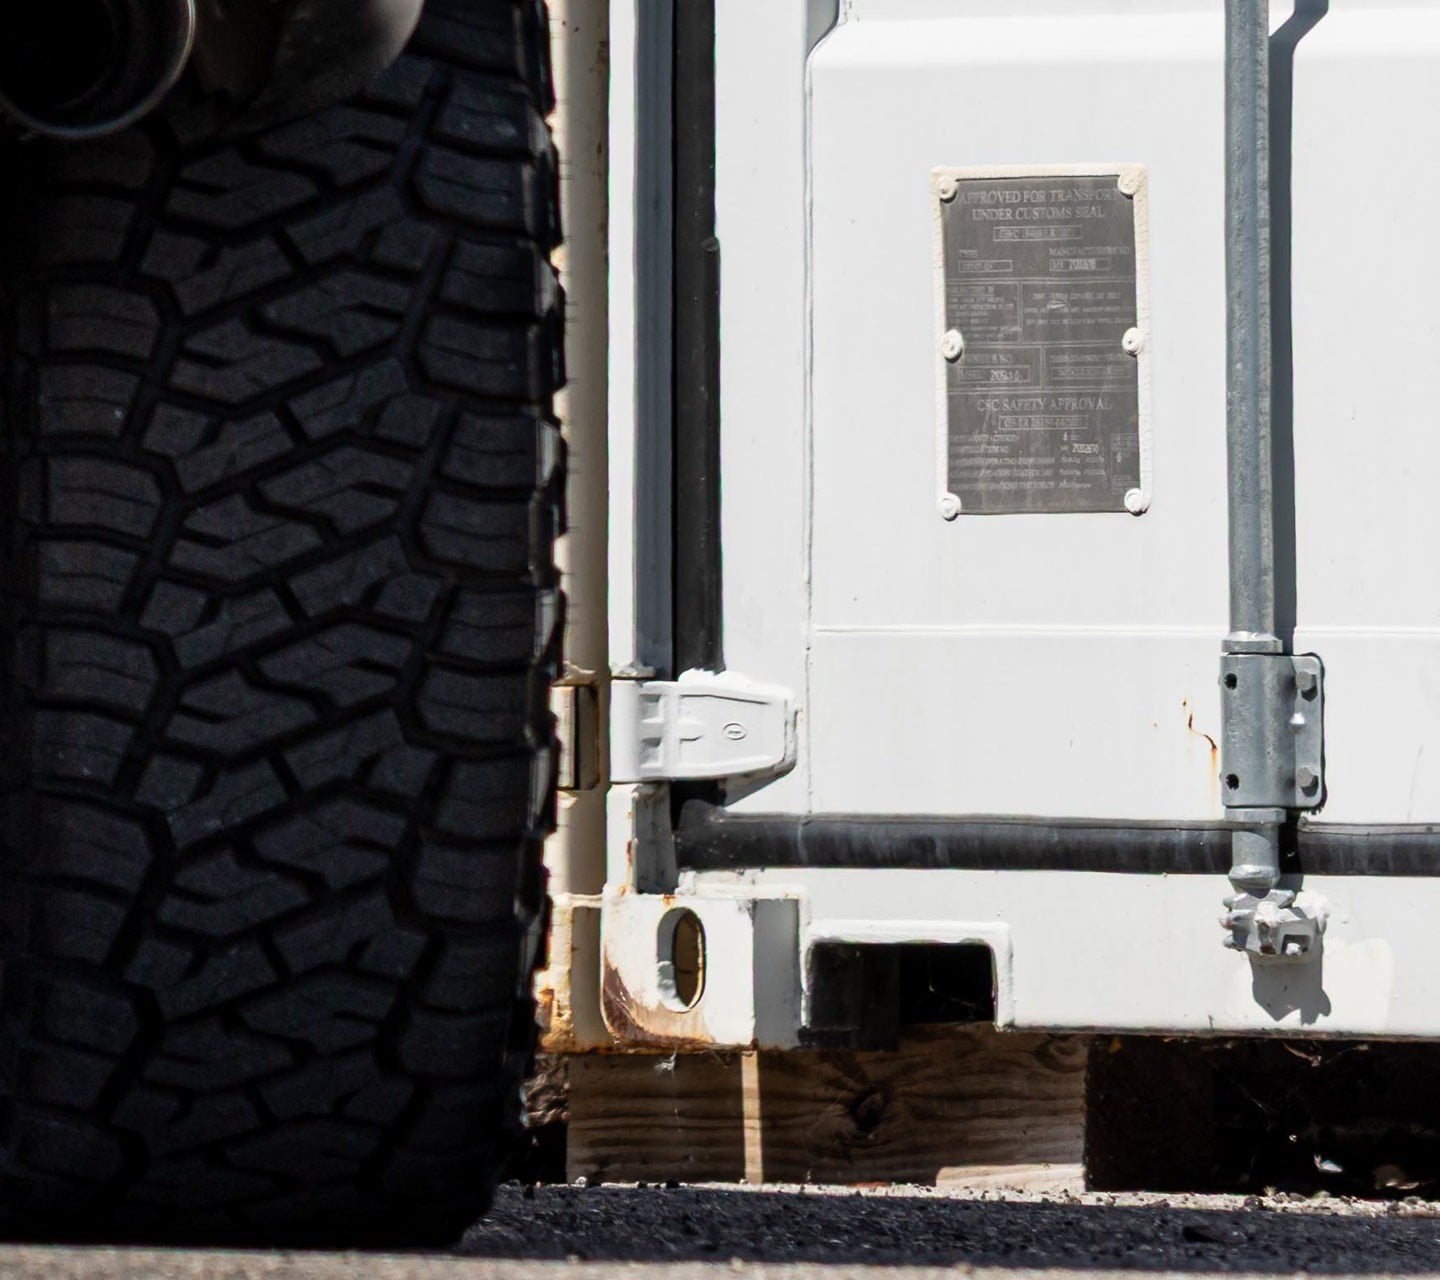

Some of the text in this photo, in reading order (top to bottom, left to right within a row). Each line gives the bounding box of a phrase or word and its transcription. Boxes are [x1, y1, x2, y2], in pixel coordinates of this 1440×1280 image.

[1023, 189, 1047, 203] FOR
[972, 205, 1105, 220] UNDER CUSTOMS SEAL
[1002, 397, 1047, 411] SAFETY
[1049, 396, 1113, 411] APPROVAL
